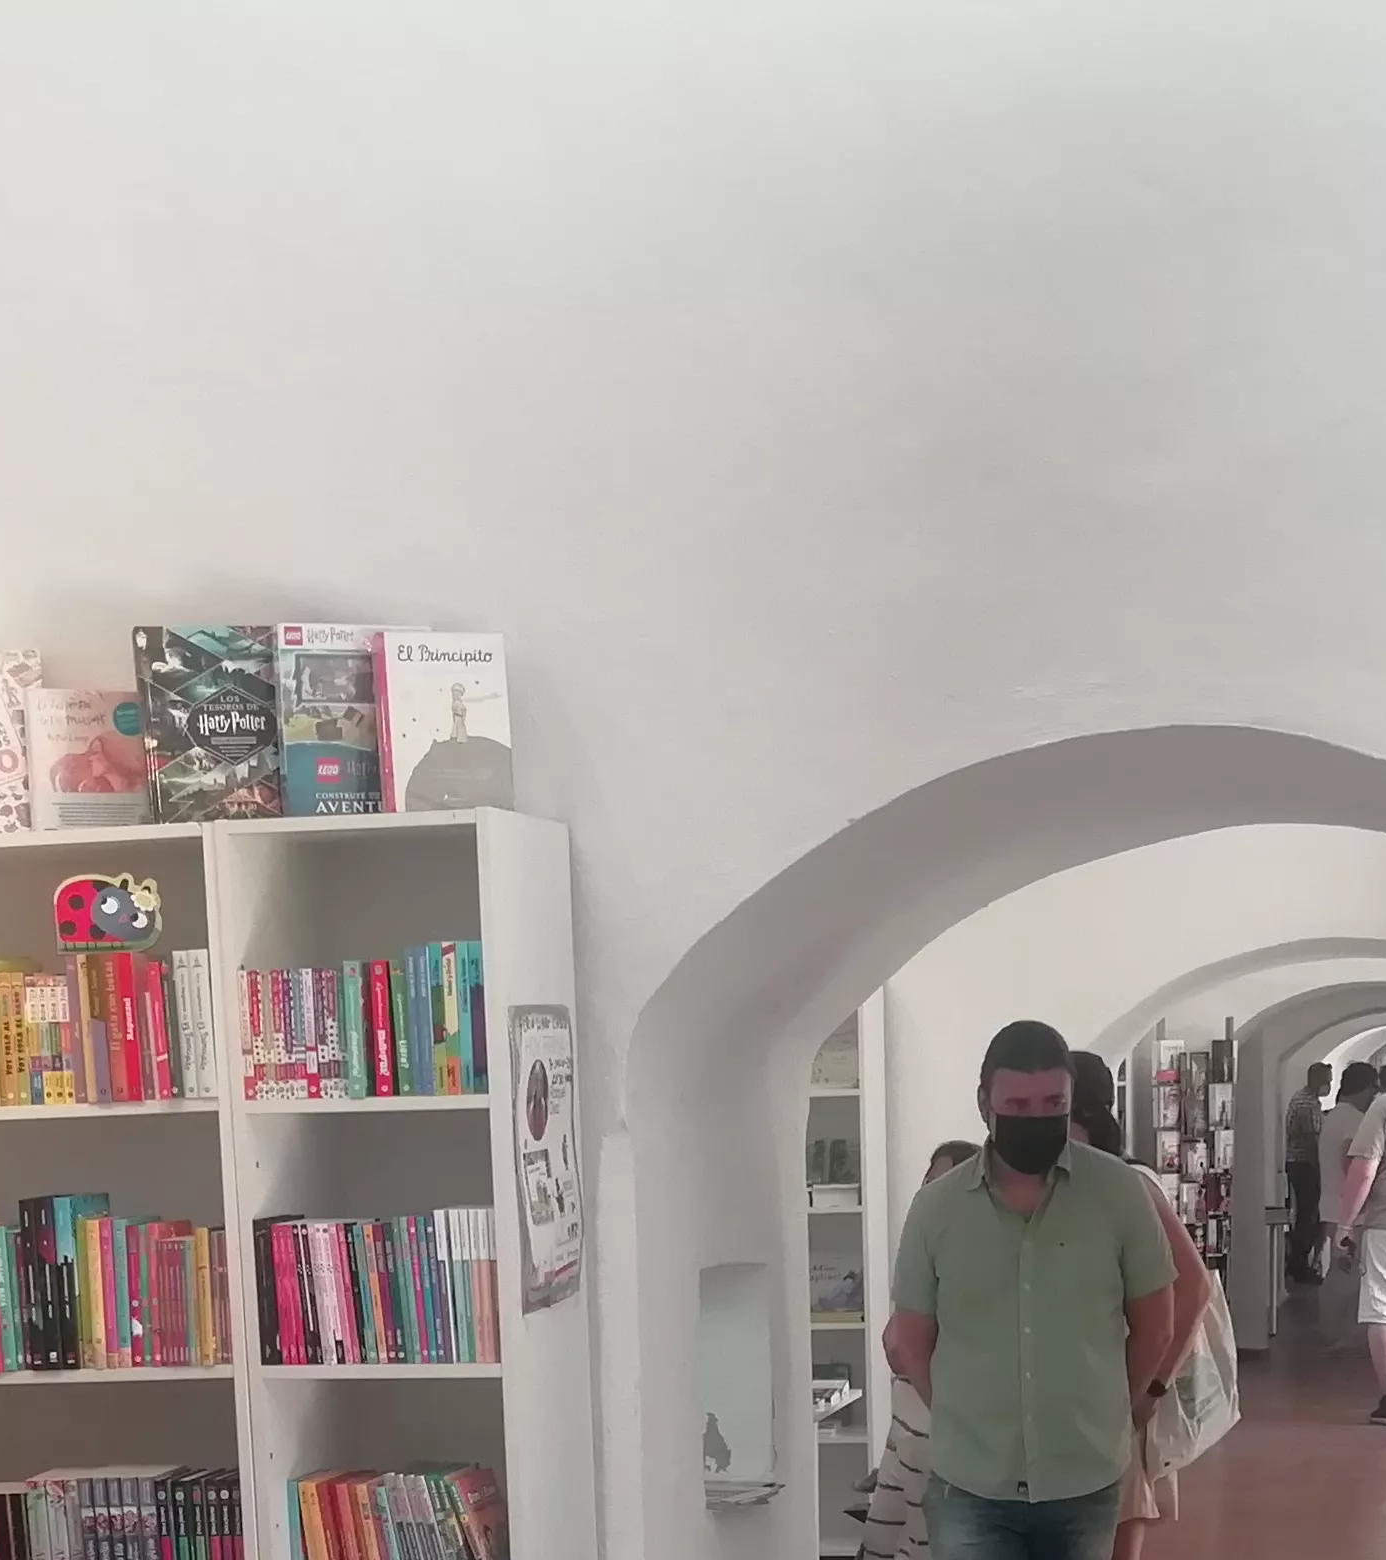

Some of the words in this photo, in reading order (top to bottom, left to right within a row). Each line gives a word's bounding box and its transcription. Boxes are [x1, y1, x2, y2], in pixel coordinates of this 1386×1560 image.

[397, 645, 413, 662] El
[419, 643, 493, 664] Principito
[198, 712, 231, 736] Harry
[231, 710, 267, 732] Potter
